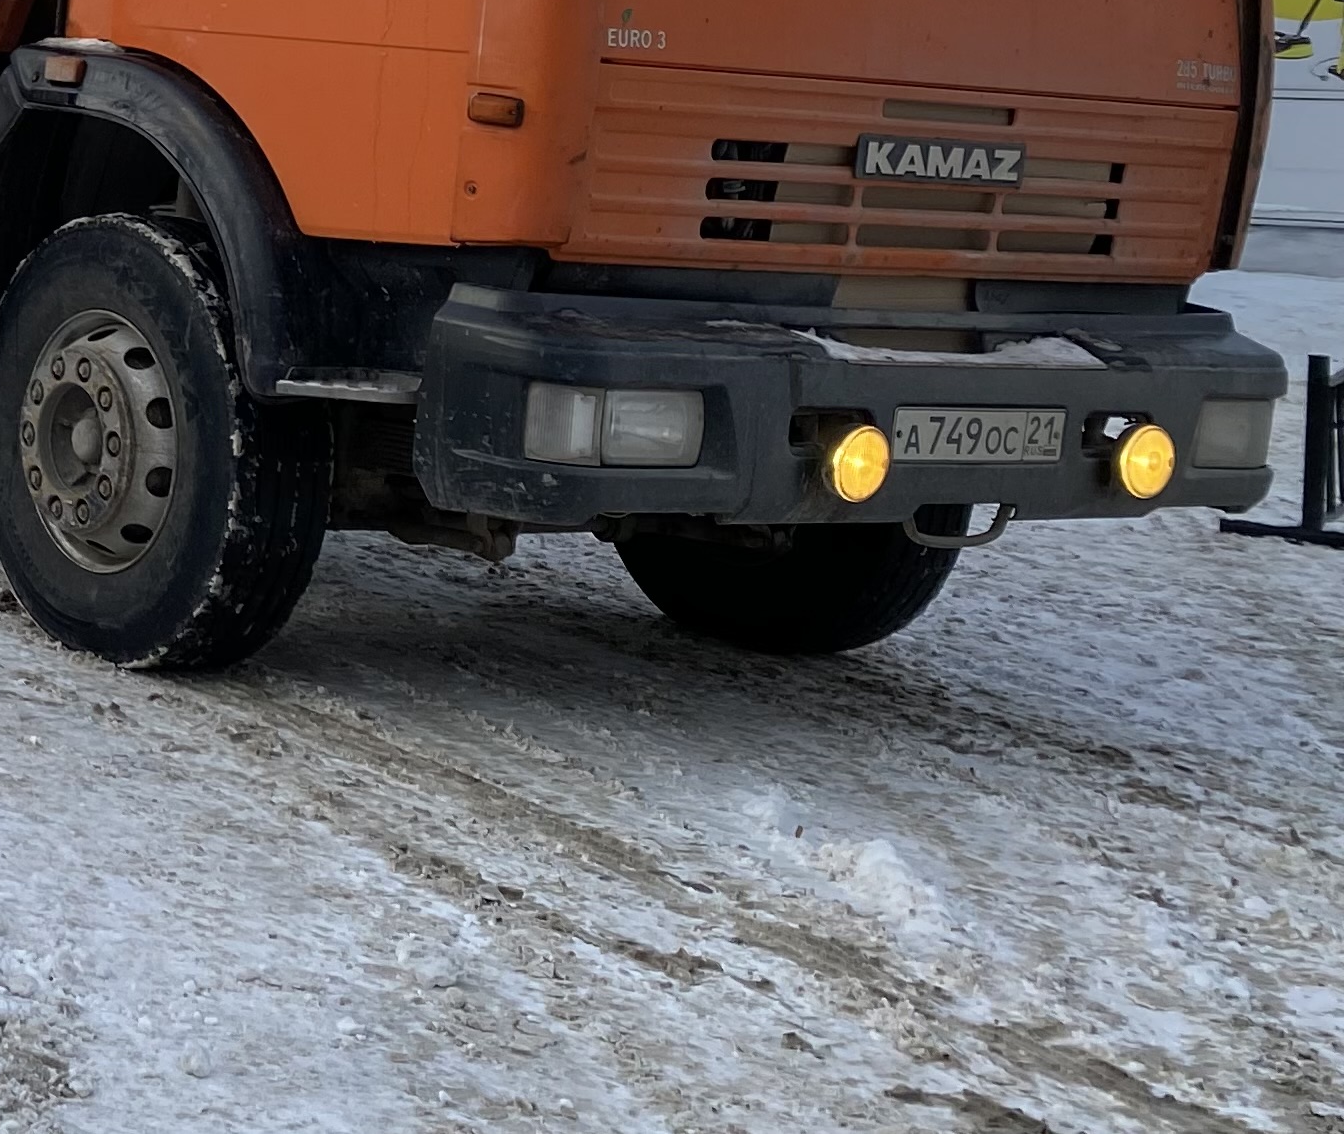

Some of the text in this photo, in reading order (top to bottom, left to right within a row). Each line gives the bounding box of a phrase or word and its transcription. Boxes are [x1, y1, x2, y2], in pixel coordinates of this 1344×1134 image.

[608, 28, 666, 49] EURO 3
[865, 141, 1021, 181] KAMAZ
[1028, 416, 1055, 444] 21
